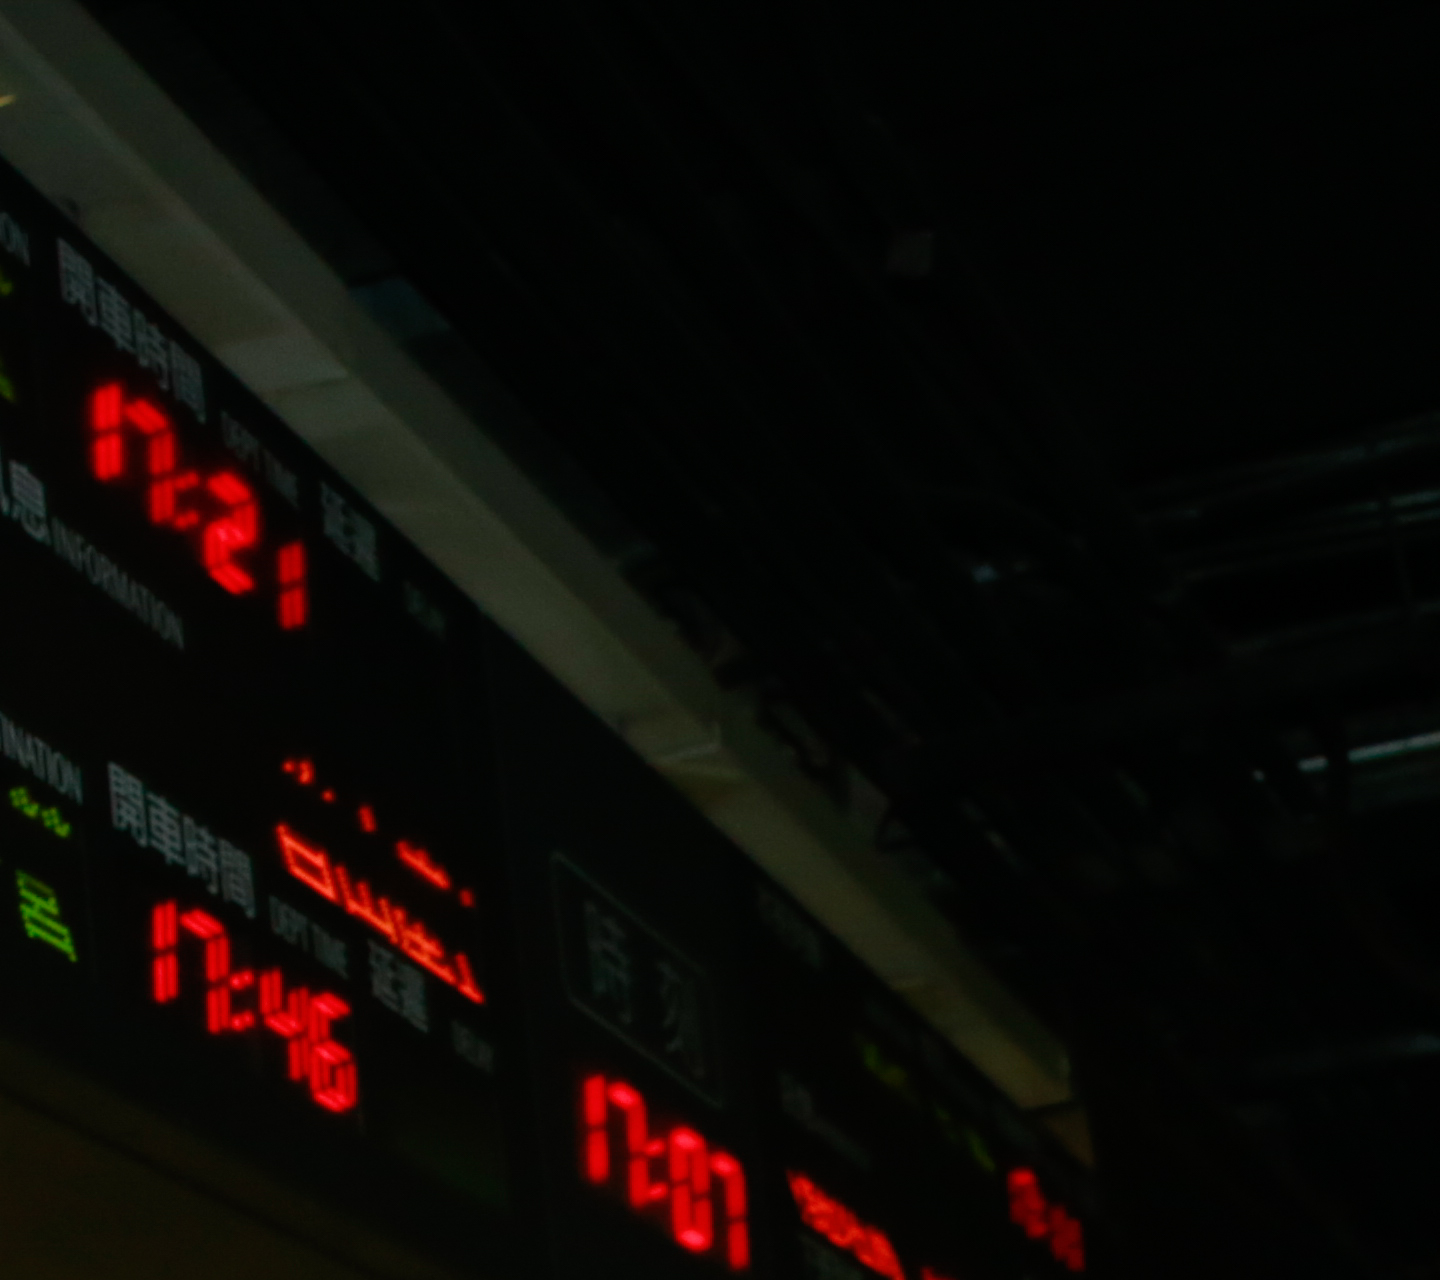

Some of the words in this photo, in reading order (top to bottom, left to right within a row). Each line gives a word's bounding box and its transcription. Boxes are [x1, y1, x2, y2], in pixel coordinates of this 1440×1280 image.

[50, 515, 185, 651] INFORMATION
[87, 378, 312, 632] 17:21
[106, 760, 257, 920] 開車時間
[150, 898, 359, 1113] 17:46
